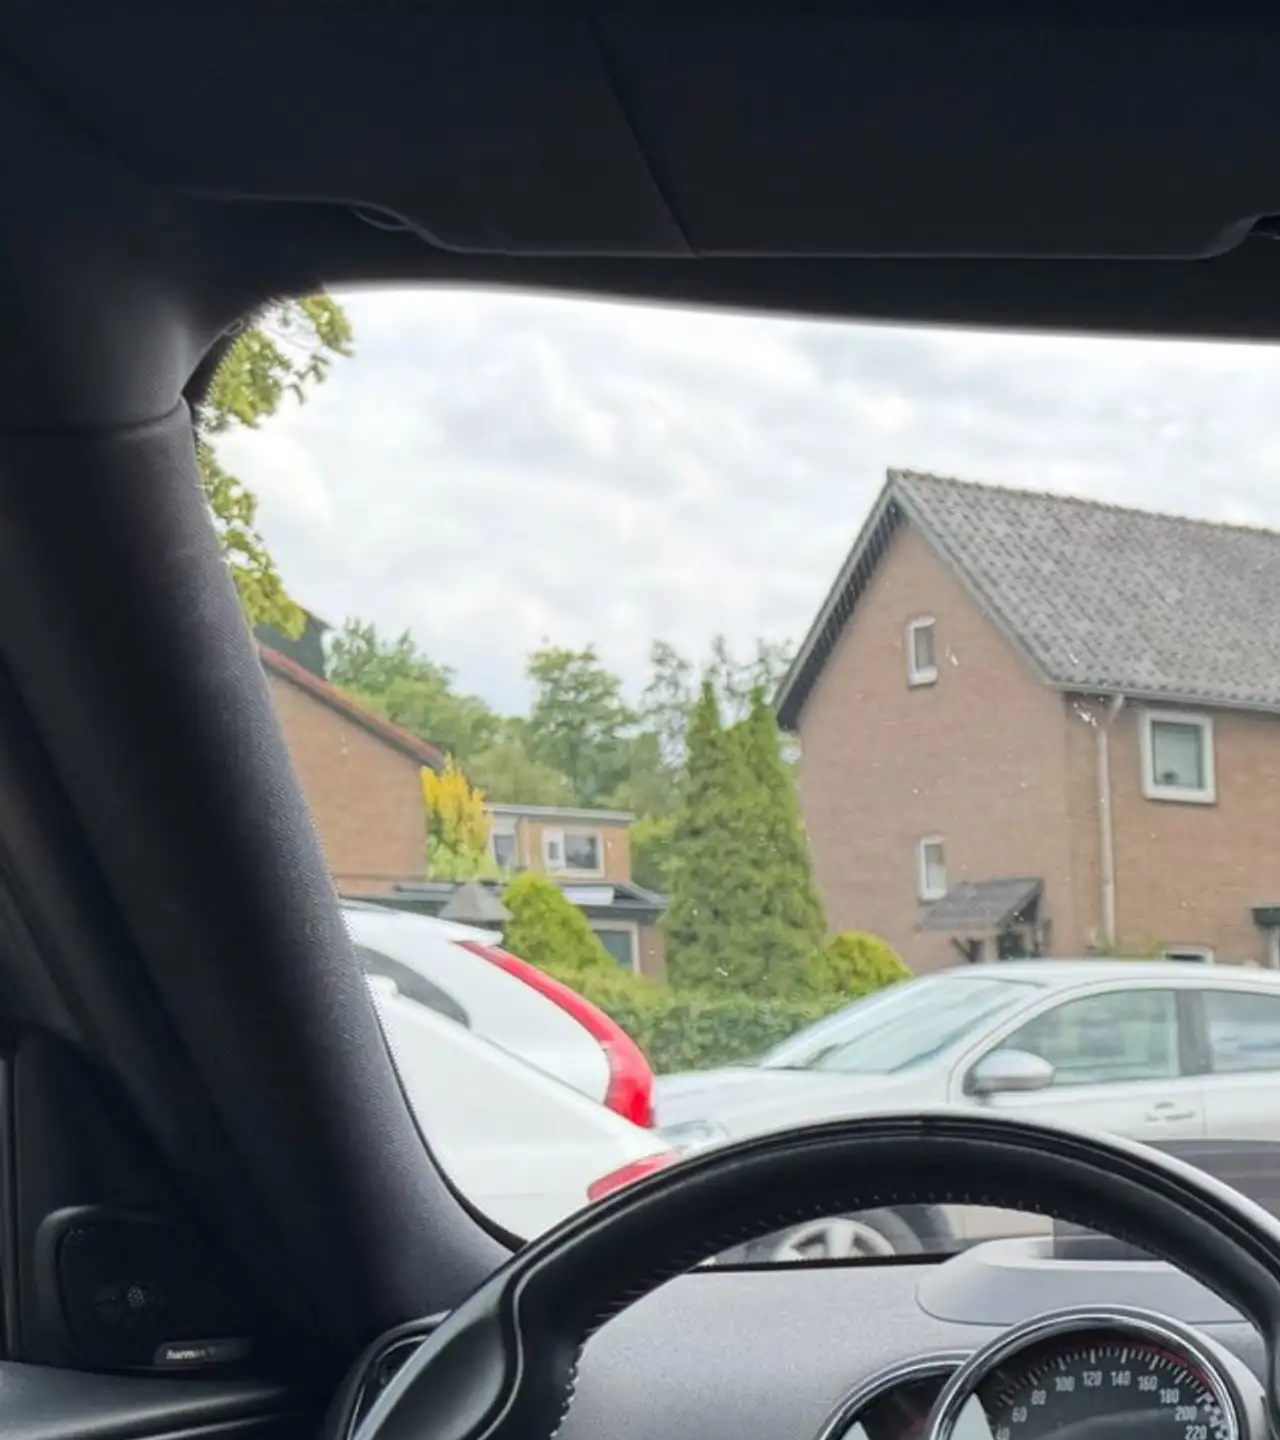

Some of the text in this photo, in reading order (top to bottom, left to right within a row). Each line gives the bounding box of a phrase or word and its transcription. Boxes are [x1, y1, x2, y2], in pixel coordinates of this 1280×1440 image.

[1054, 1376, 1075, 1392] 100
[1082, 1370, 1103, 1386] 120
[1110, 1370, 1132, 1386] 140
[1137, 1375, 1158, 1392] 160
[1160, 1387, 1180, 1404] 180
[1012, 1406, 1027, 1423] 60
[1174, 1405, 1198, 1421] 200
